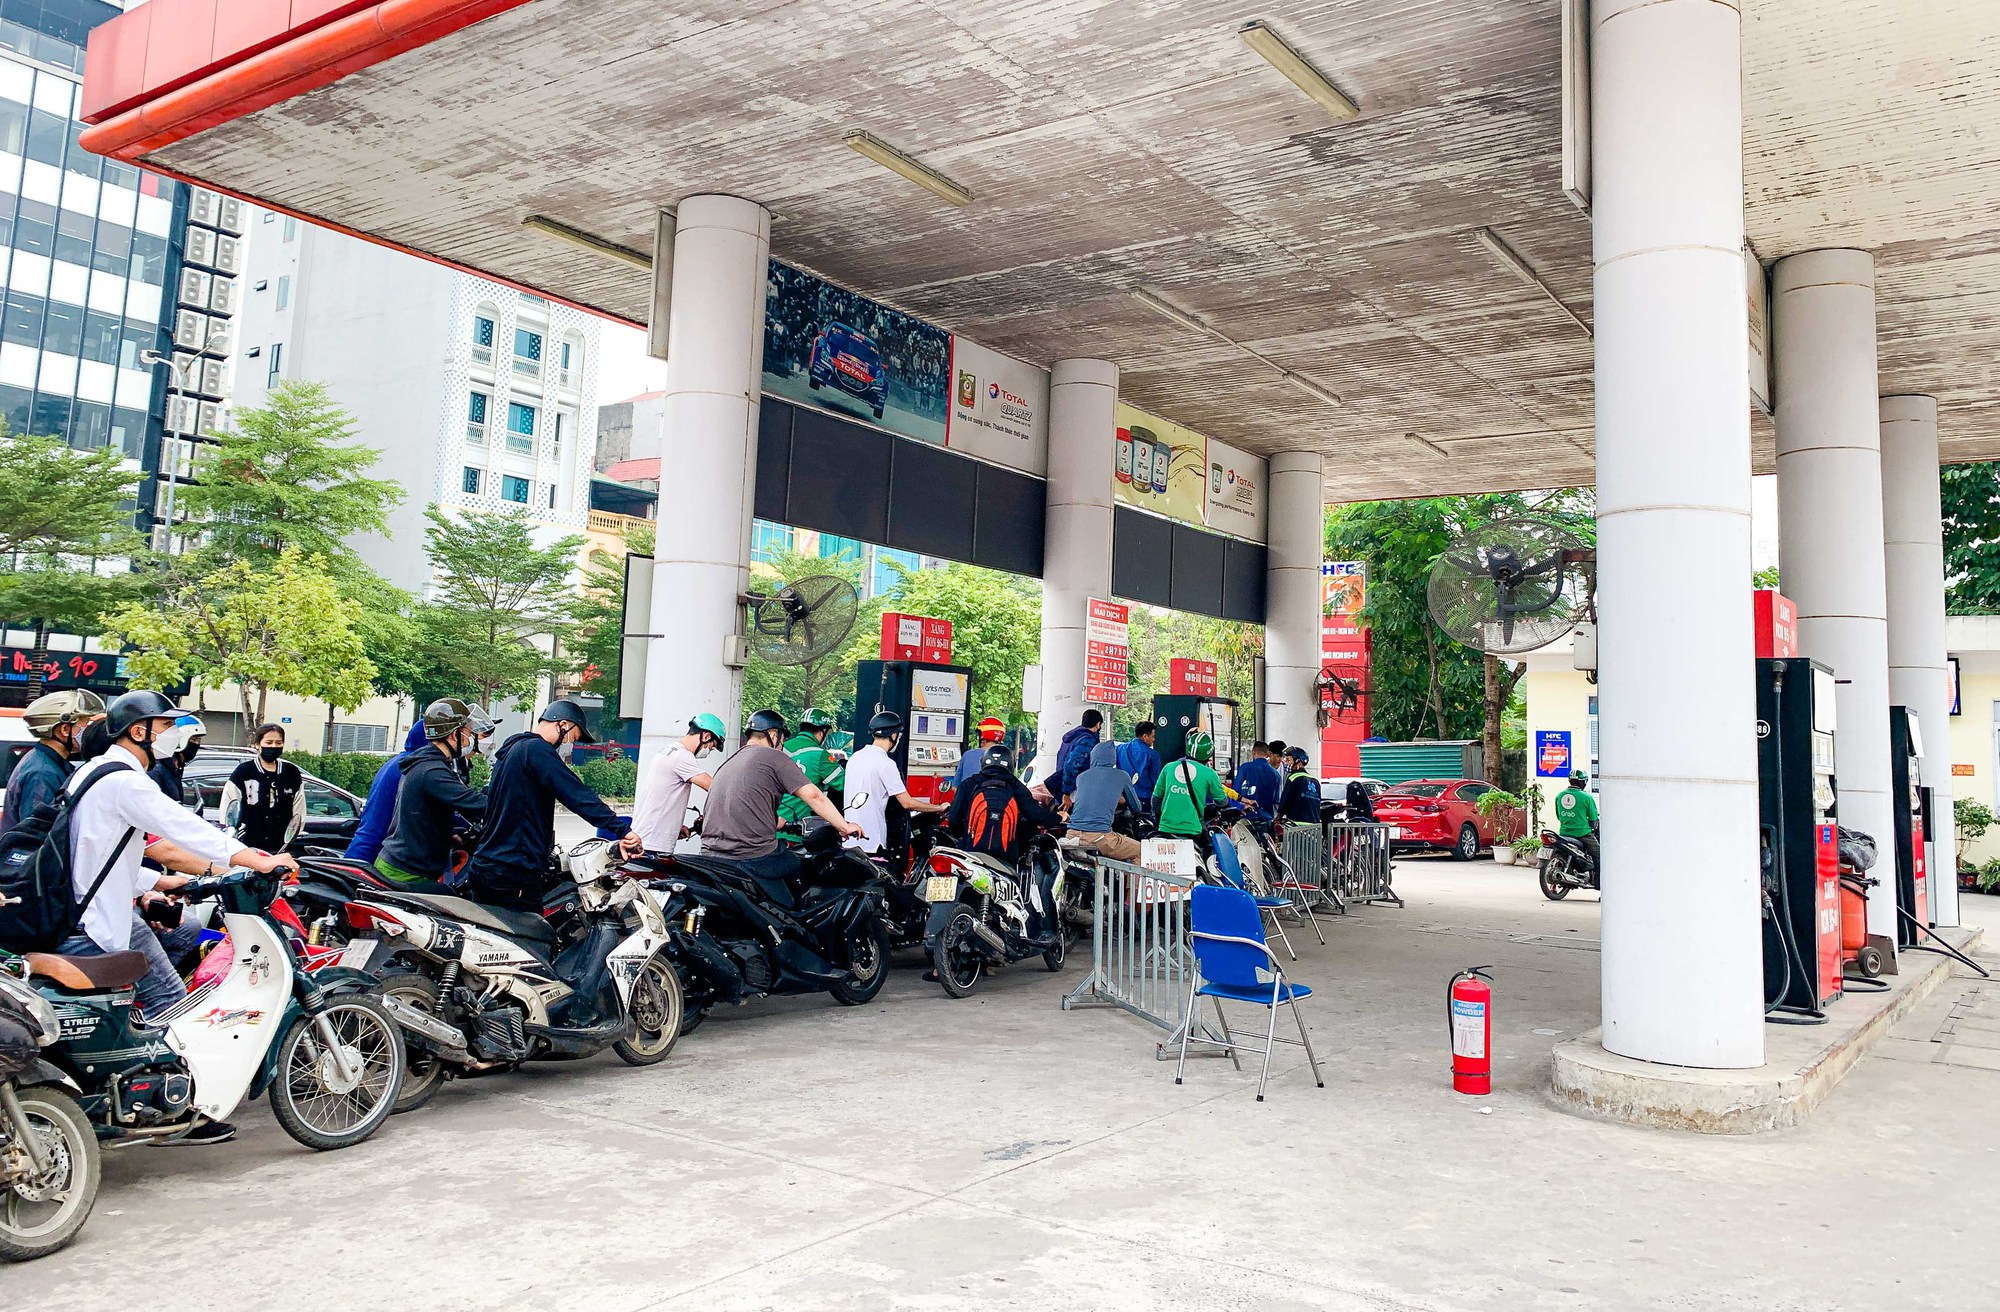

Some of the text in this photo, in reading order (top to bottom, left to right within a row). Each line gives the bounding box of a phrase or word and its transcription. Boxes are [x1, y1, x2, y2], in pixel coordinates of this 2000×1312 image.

[840, 362, 866, 380] TOTAL
[1001, 389, 1028, 407] TOTAL
[1001, 402, 1033, 421] QUARTZ
[1236, 475, 1256, 489] TOTAL
[68, 656, 98, 678] 90
[1104, 676, 1125, 686] 27050
[1103, 691, 1125, 701] 25070
[434, 933, 456, 949] LX
[479, 953, 509, 963] YAMAHA
[545, 989, 561, 1000] YAMAHA
[63, 1017, 100, 1027] STREET
